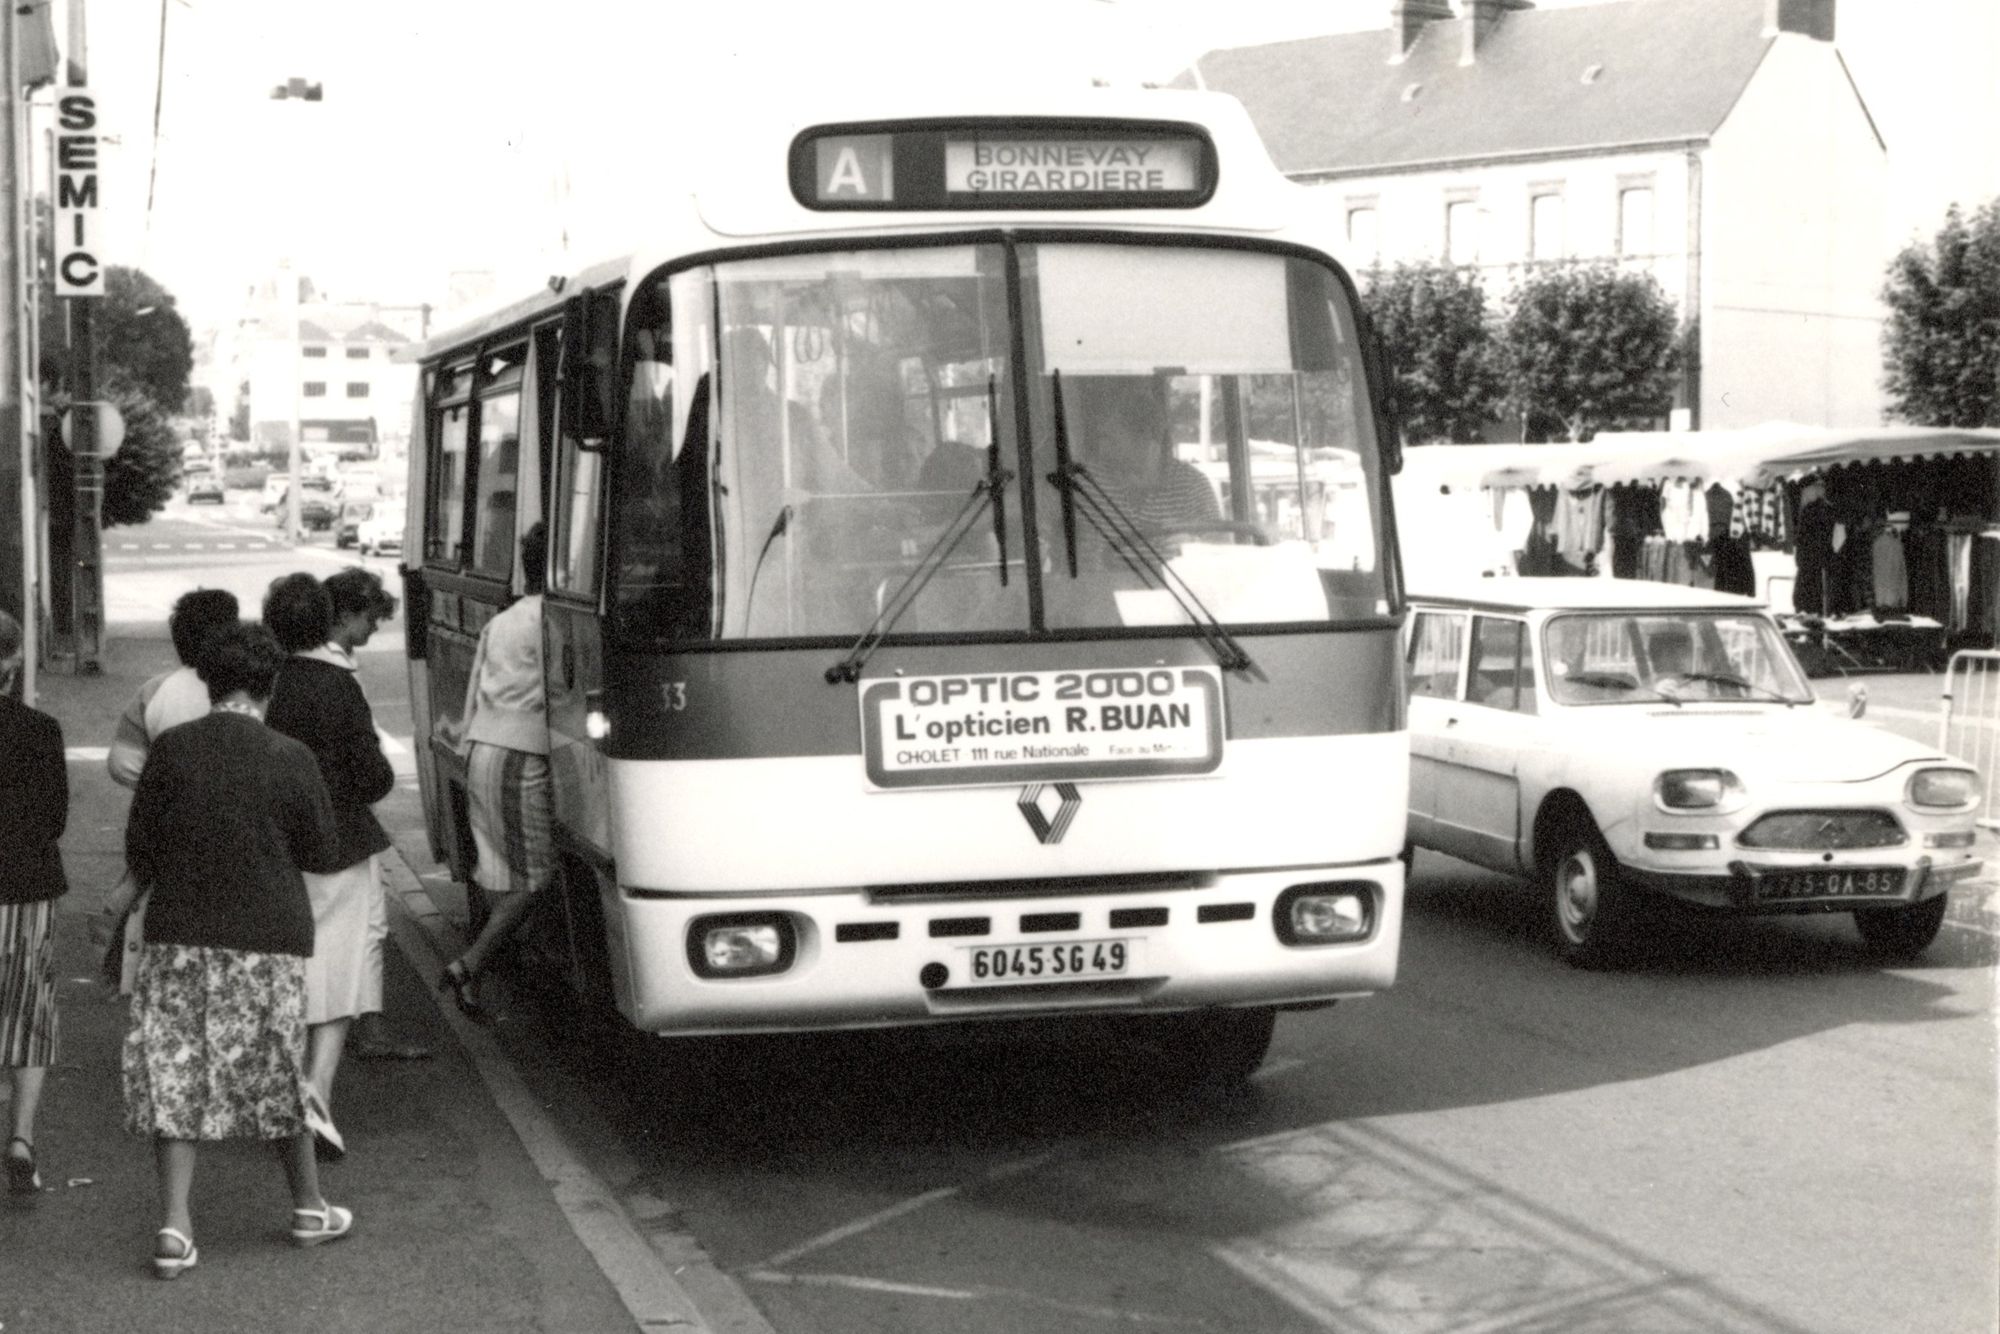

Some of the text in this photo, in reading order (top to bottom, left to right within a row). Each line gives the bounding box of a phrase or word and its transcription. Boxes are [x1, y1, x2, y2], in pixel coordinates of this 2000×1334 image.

[827, 147, 868, 195] A
[974, 146, 1154, 167] BONNEVAY
[58, 95, 99, 287] SEMIC
[966, 169, 1164, 191] GIRARDIERE
[908, 670, 1175, 707] OPTIC 2000
[895, 712, 1050, 744] L'opticien
[896, 748, 961, 765] CHOLET
[971, 747, 989, 761] 111
[994, 748, 1018, 760] rue
[1022, 742, 1090, 759] Nationale
[973, 947, 1044, 978] 6045
[1091, 942, 1126, 971] 49
